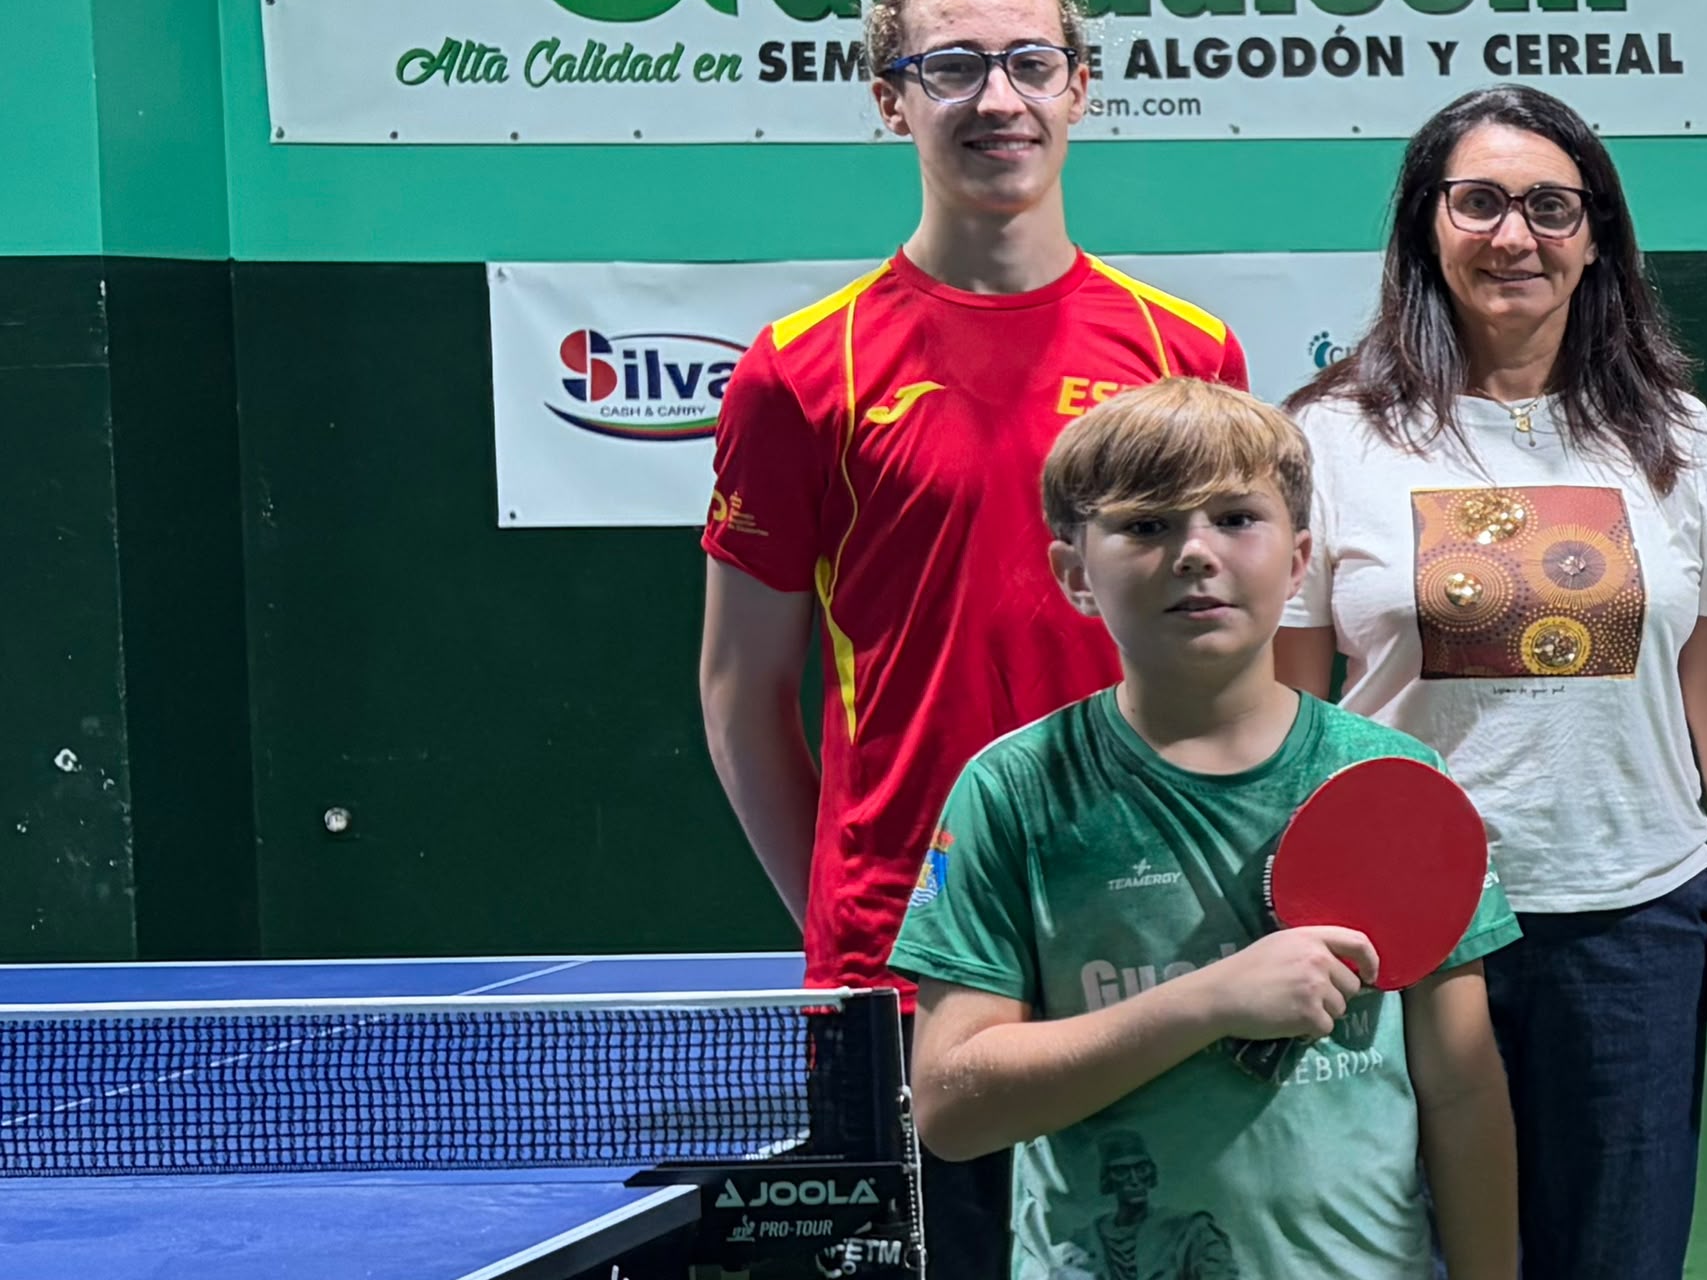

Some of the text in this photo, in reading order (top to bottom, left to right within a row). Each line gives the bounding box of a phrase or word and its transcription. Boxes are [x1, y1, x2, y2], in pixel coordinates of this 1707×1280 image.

[395, 37, 509, 85] Alta
[524, 37, 686, 88] Calidad
[692, 53, 743, 83] en
[1124, 24, 1403, 80] ALGODÓN
[1428, 41, 1460, 77] Y
[1482, 33, 1685, 77] CEREAL
[600, 405, 641, 418] CASH
[658, 404, 706, 418] CARRY
[1282, 1046, 1383, 1087] EBRIJA
[750, 1179, 880, 1207] JOOLA
[759, 1219, 833, 1238] PRO-TOUR
